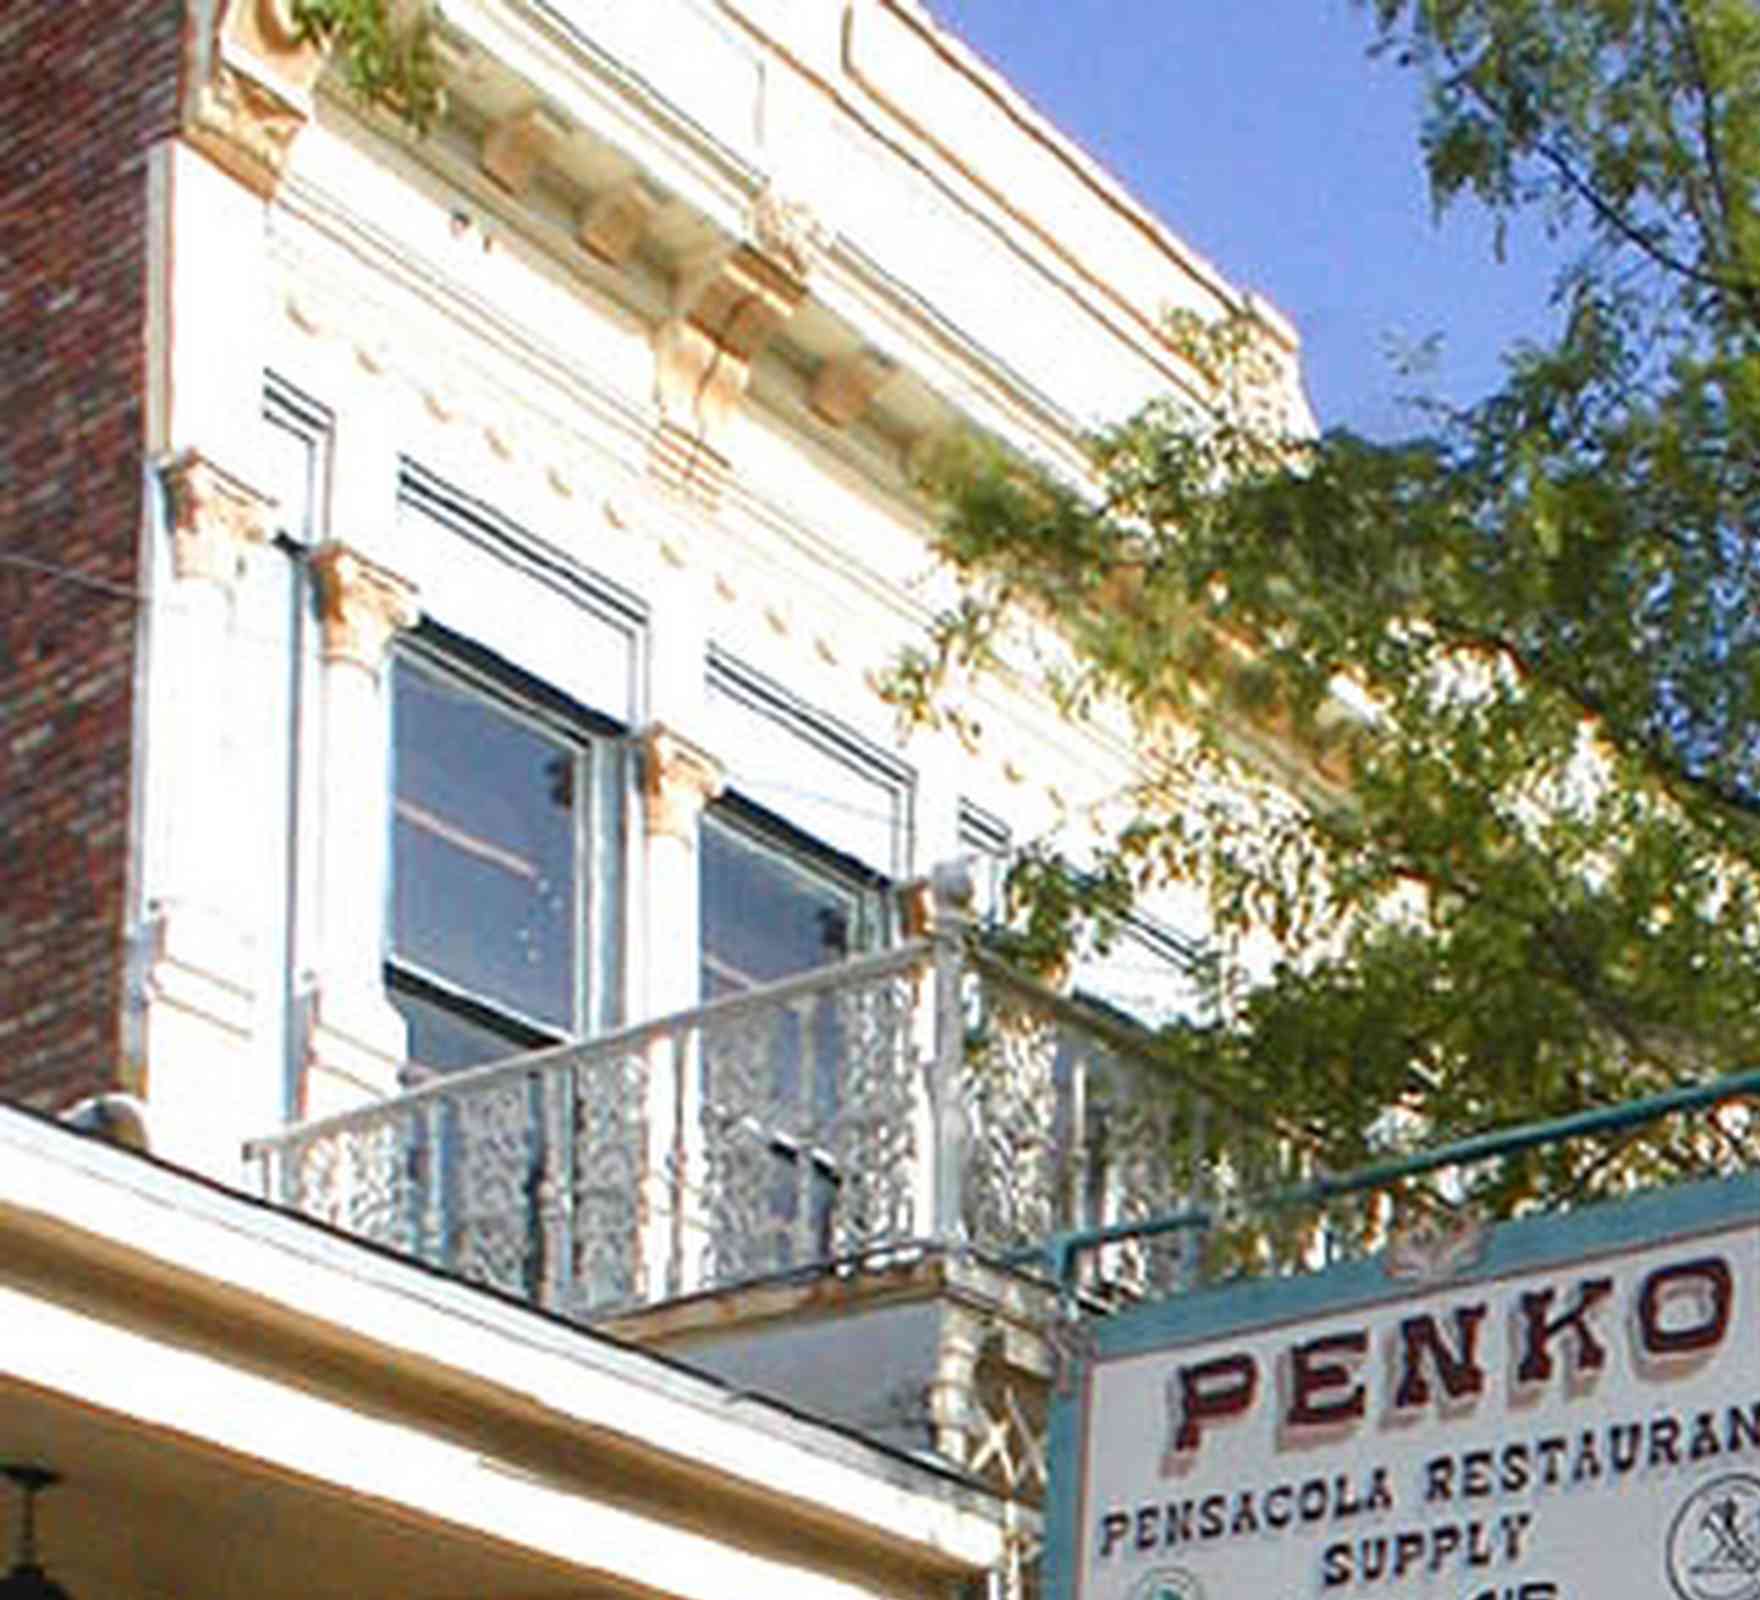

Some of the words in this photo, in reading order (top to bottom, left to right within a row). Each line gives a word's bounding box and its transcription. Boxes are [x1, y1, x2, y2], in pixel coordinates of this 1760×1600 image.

[1166, 1256, 1734, 1457] PENKO
[1098, 1467, 1393, 1557] PENSACOLA
[1321, 1512, 1533, 1588] SUPPLY
